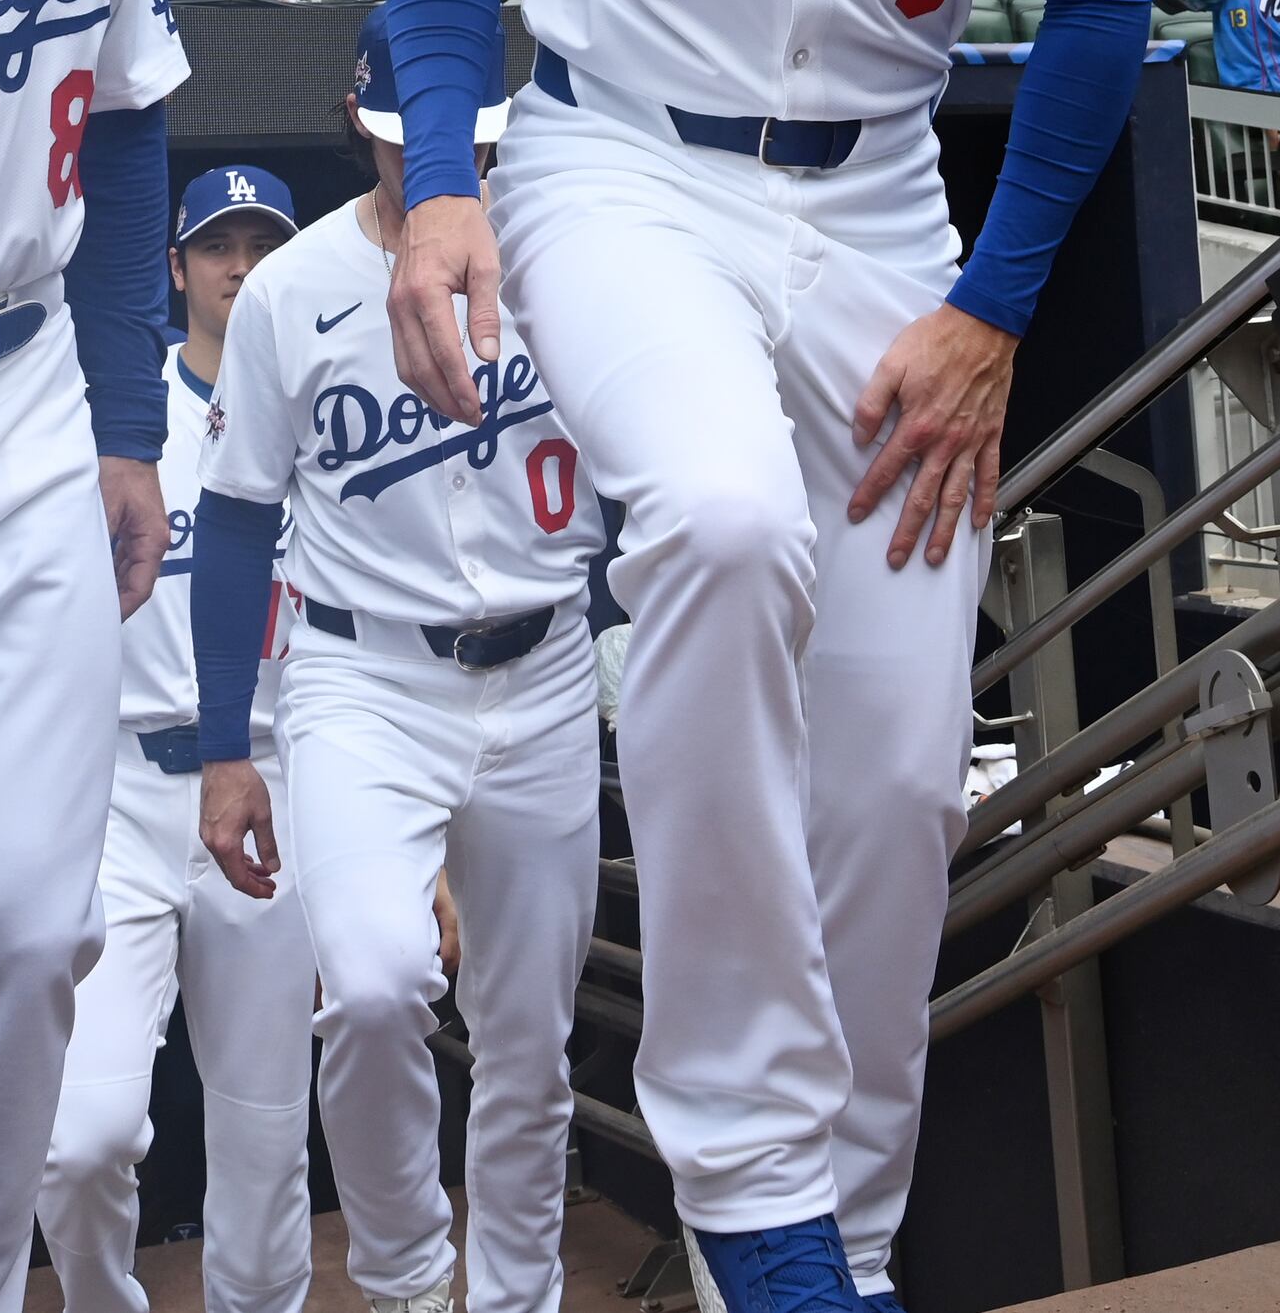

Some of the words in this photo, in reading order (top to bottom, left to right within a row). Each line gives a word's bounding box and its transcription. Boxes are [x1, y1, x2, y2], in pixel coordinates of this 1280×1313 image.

[1230, 8, 1248, 28] 13
[47, 69, 95, 209] 8
[225, 170, 257, 202] LA
[525, 438, 578, 535] 0
